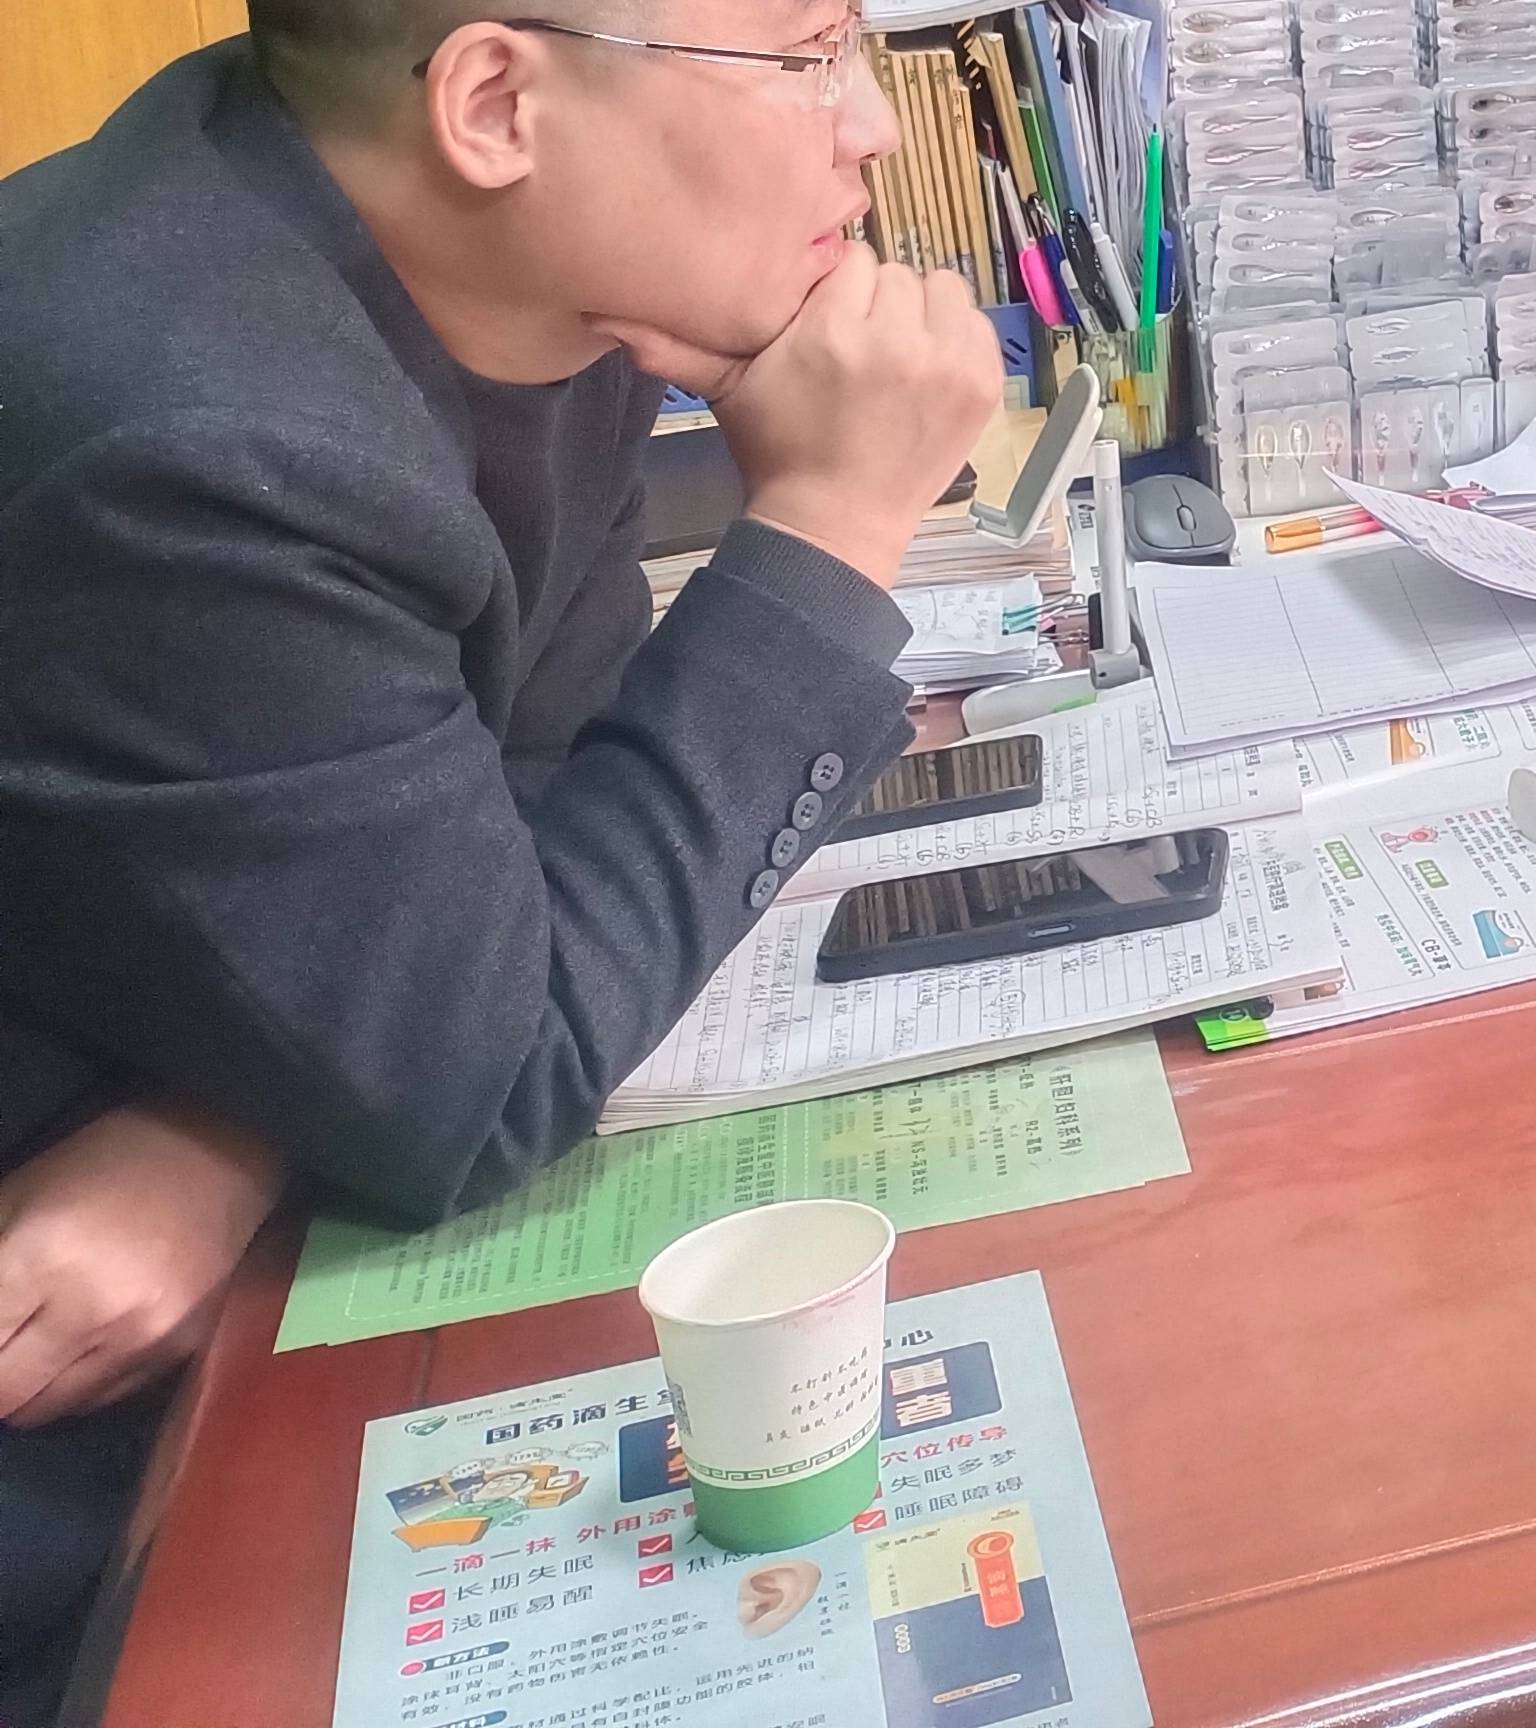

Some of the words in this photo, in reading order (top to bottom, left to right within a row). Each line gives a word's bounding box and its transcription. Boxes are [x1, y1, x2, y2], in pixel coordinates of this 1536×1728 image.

[880, 1424, 1007, 1469] 穴位传导
[890, 1448, 1017, 1493] 失眠多梦
[415, 1535, 557, 1578] 一滴一抹
[453, 1554, 594, 1602] 长期失眠
[450, 1584, 594, 1634] 浅睡易醒
